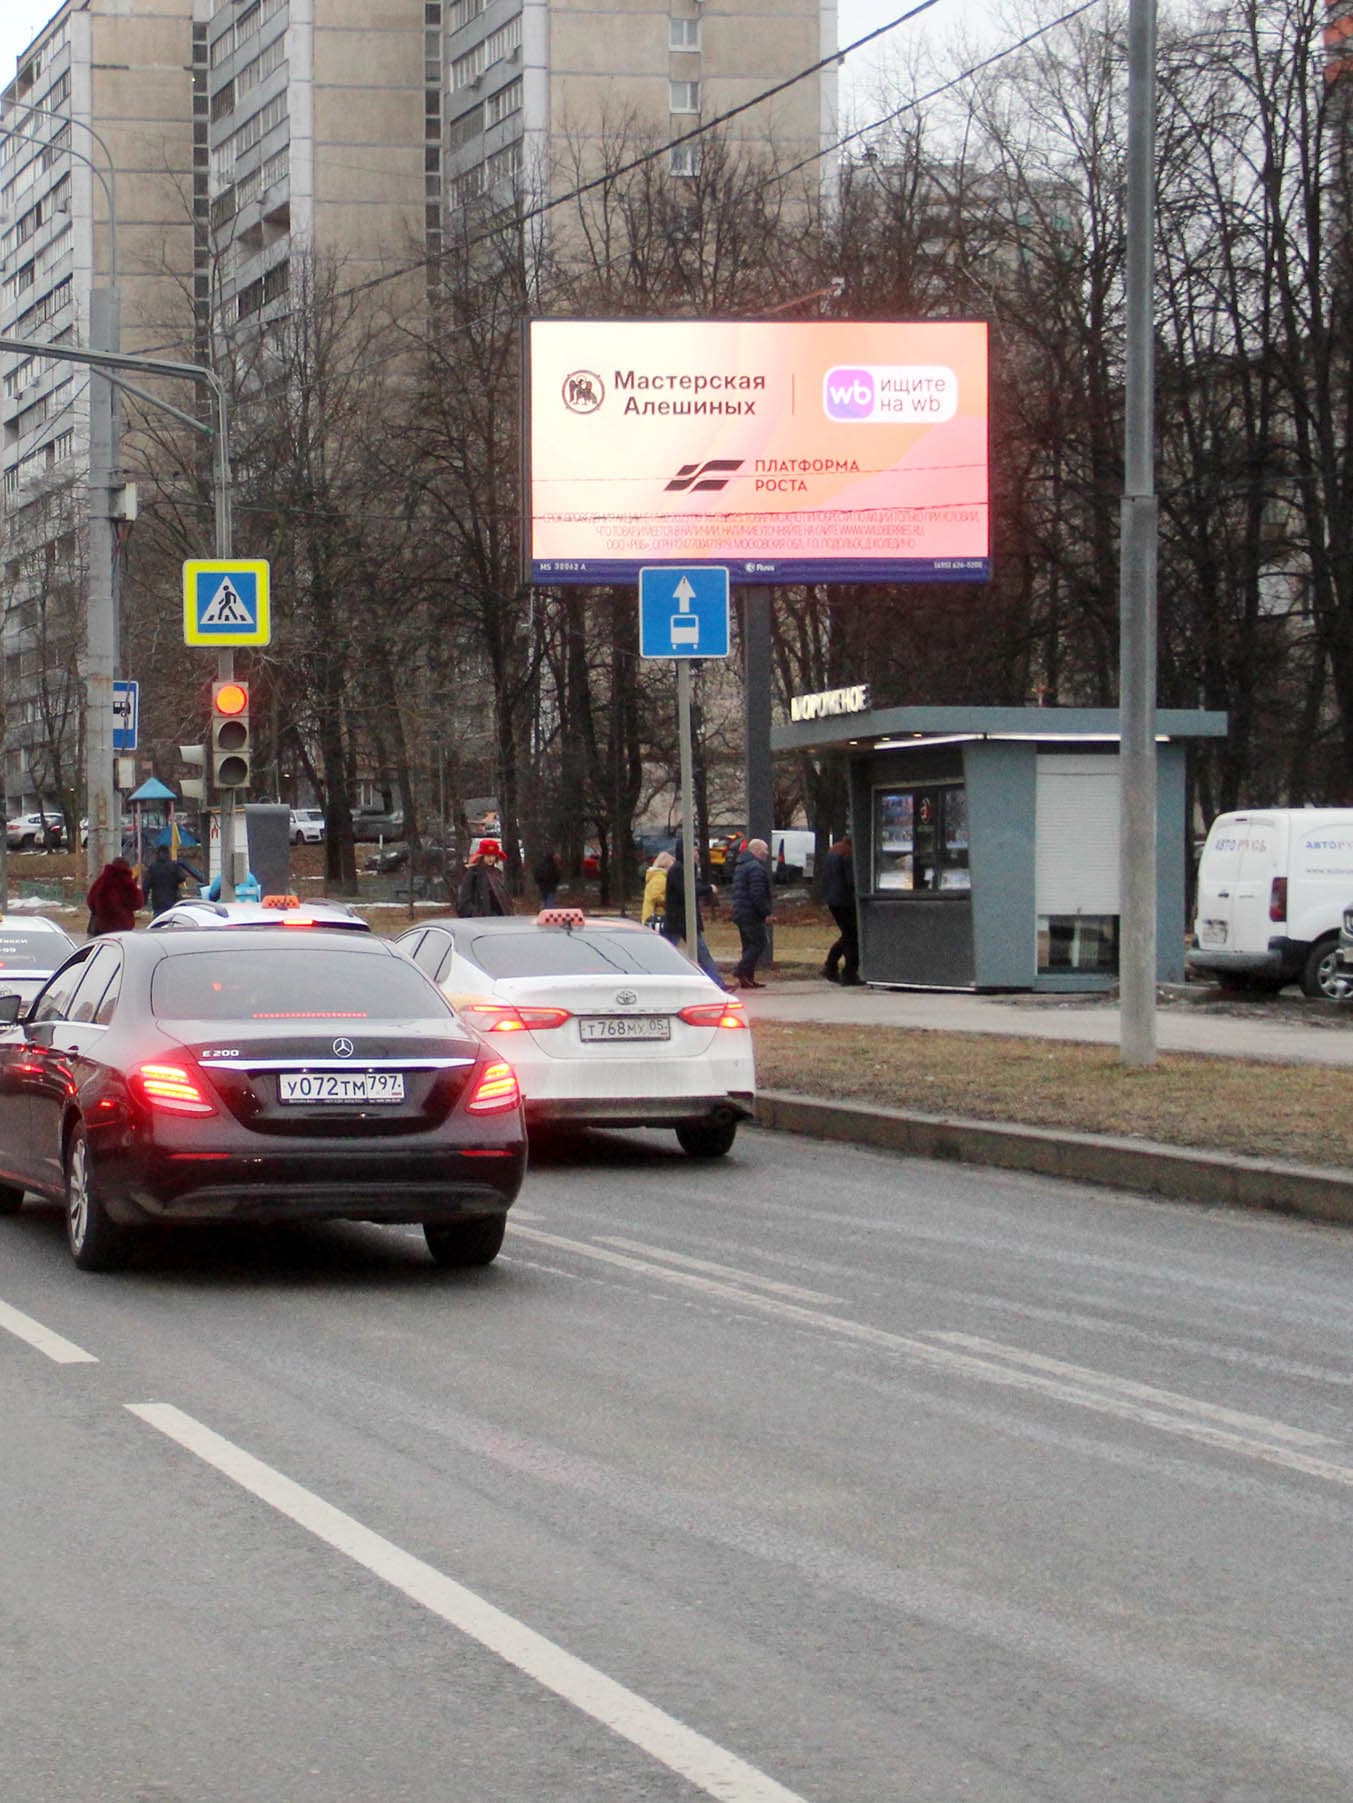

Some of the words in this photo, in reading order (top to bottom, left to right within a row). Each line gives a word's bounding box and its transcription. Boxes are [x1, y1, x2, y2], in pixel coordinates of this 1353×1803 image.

[614, 370, 766, 394] Мастерская
[880, 379, 946, 395] ищите
[829, 380, 873, 405] wb
[624, 396, 756, 415] Алешиных
[880, 399, 903, 412] на
[912, 395, 941, 412] wb
[755, 459, 860, 472] ПЛАТФОРМА
[755, 479, 808, 492] РОСТА
[287, 1077, 366, 1096] У072ТМ
[368, 1075, 398, 1091] 797
